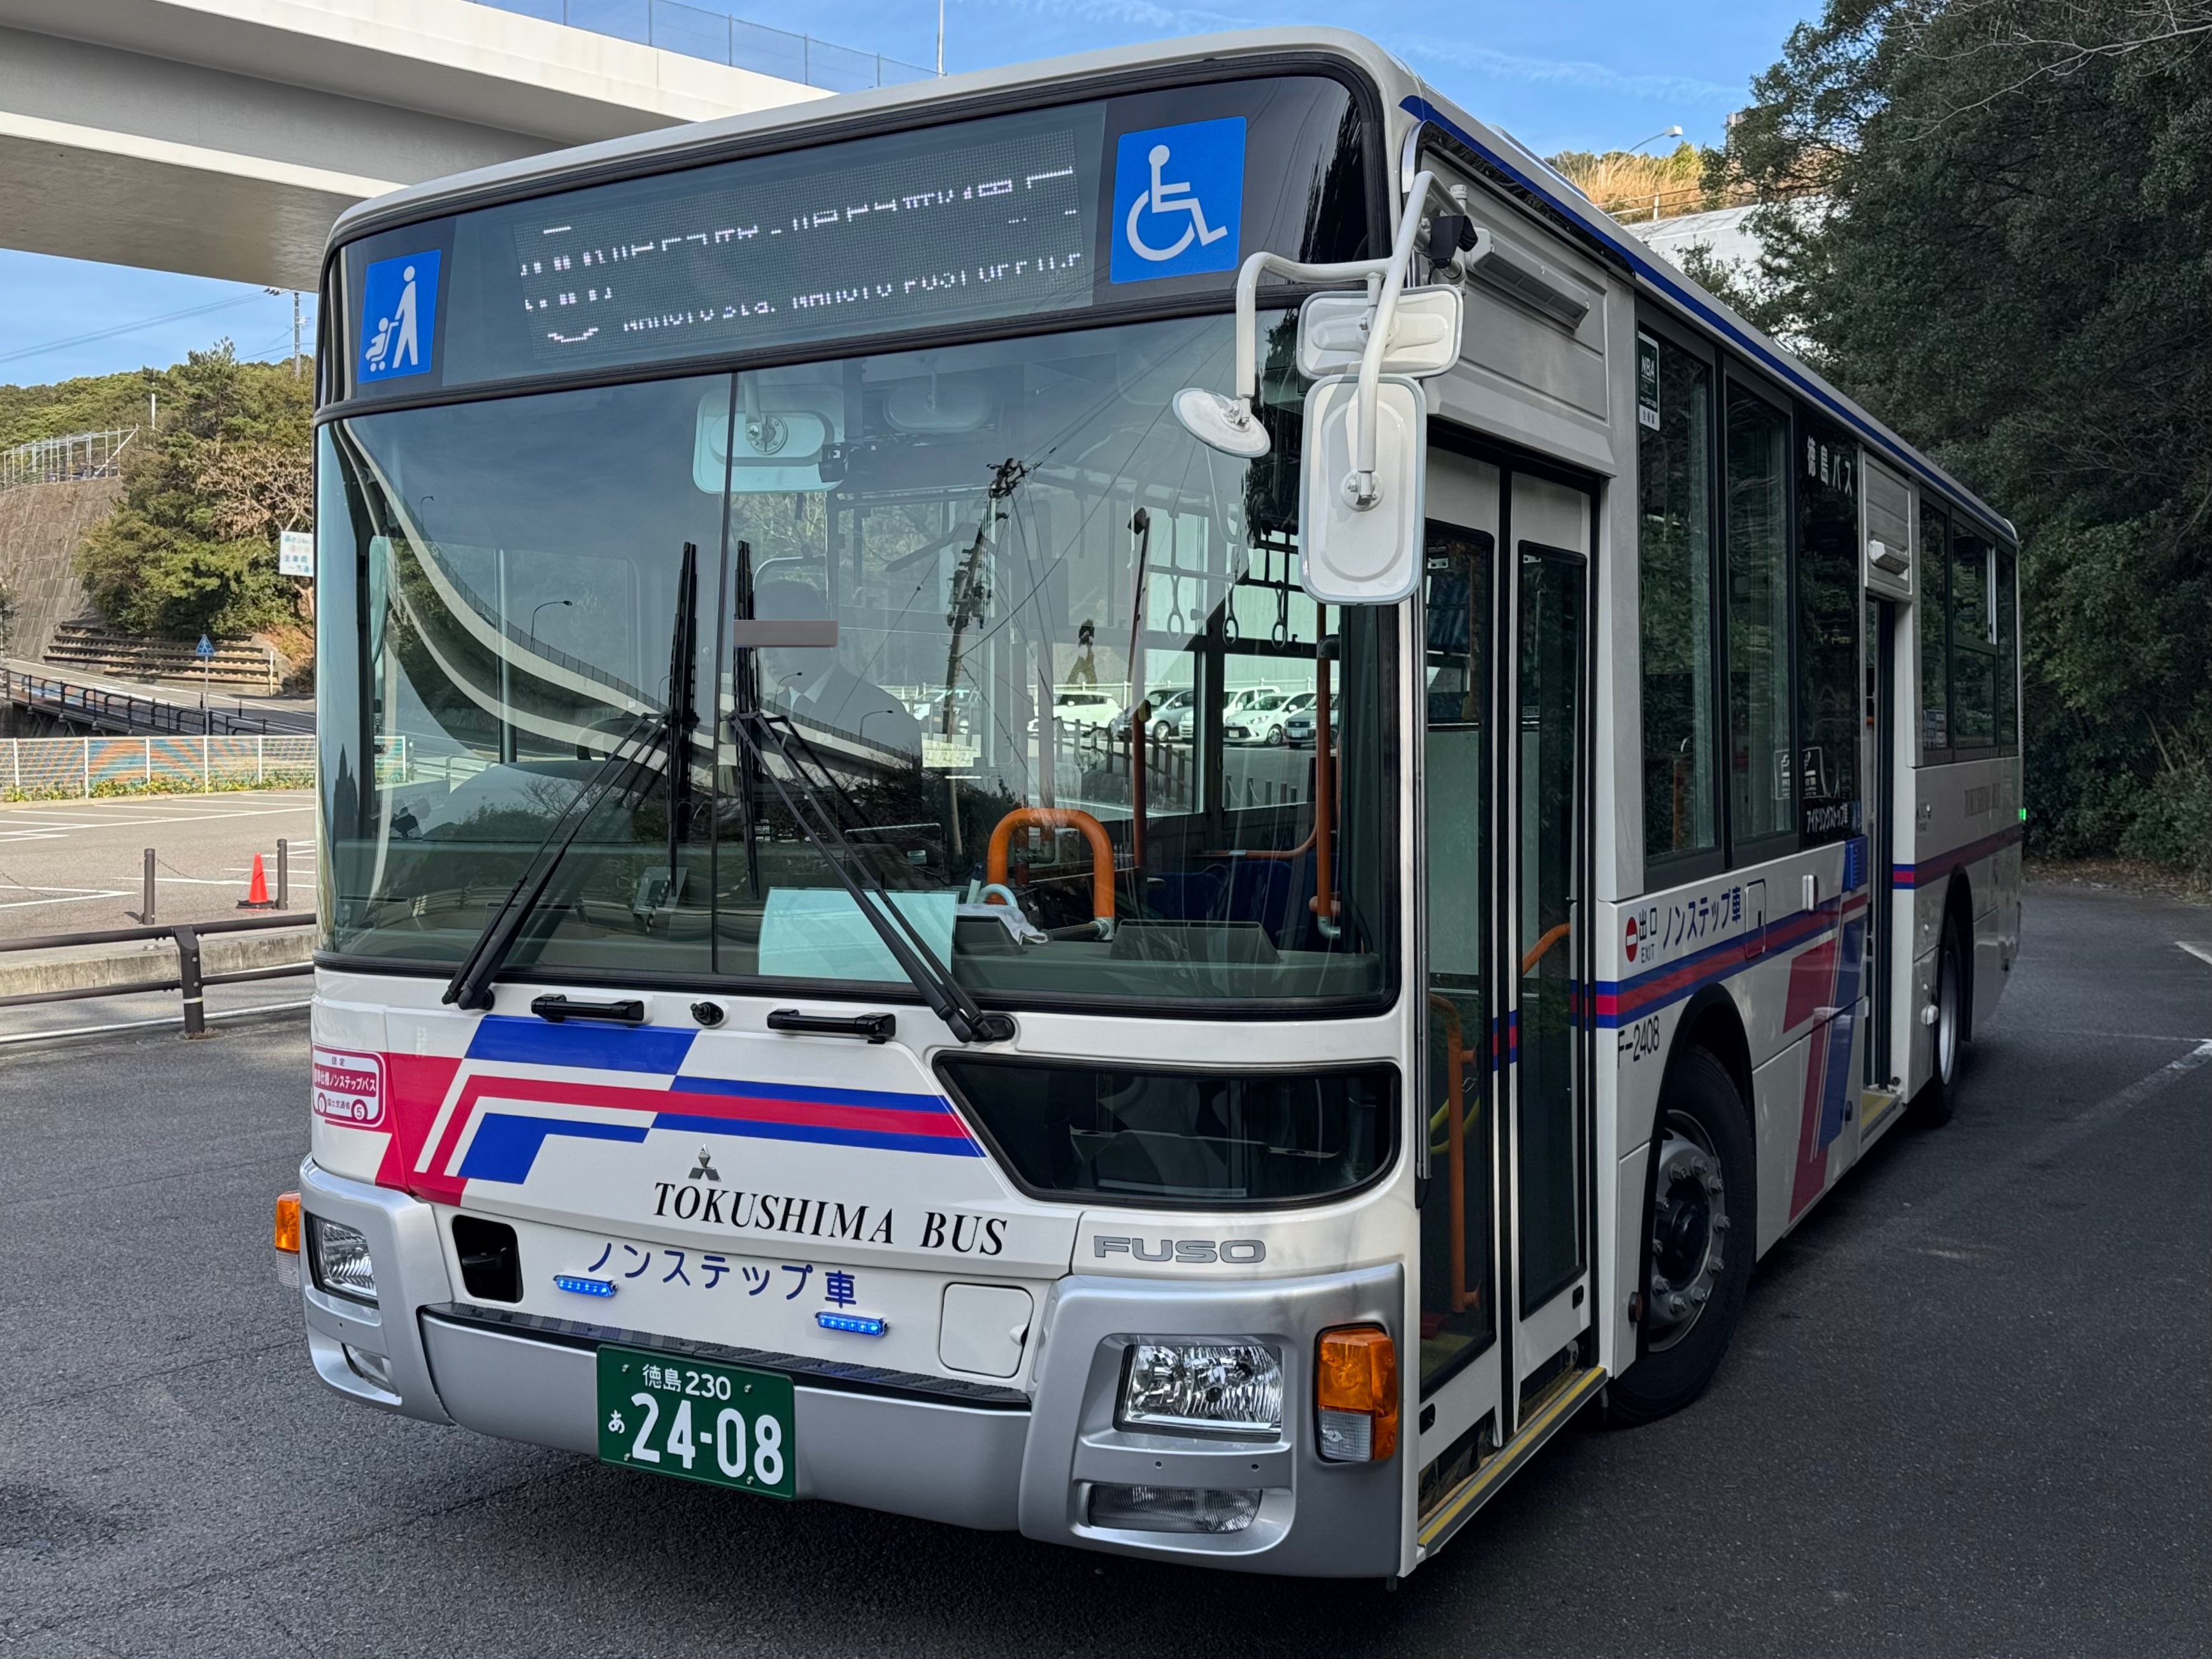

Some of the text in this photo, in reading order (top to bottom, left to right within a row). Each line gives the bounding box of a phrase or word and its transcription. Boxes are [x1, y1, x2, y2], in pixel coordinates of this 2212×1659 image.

[1639, 886, 1741, 950] 出口 ノンステップ車
[1641, 944, 1655, 964] EXIT
[1618, 1015, 1660, 1070] F-2408
[356, 1107, 362, 1118] 5
[653, 1182, 1008, 1256] TOKUSHIMA BUS
[588, 1242, 857, 1309] ノンステップ車
[1094, 1235, 1266, 1264] FUSO
[608, 1393, 784, 1485] あ 24-08
